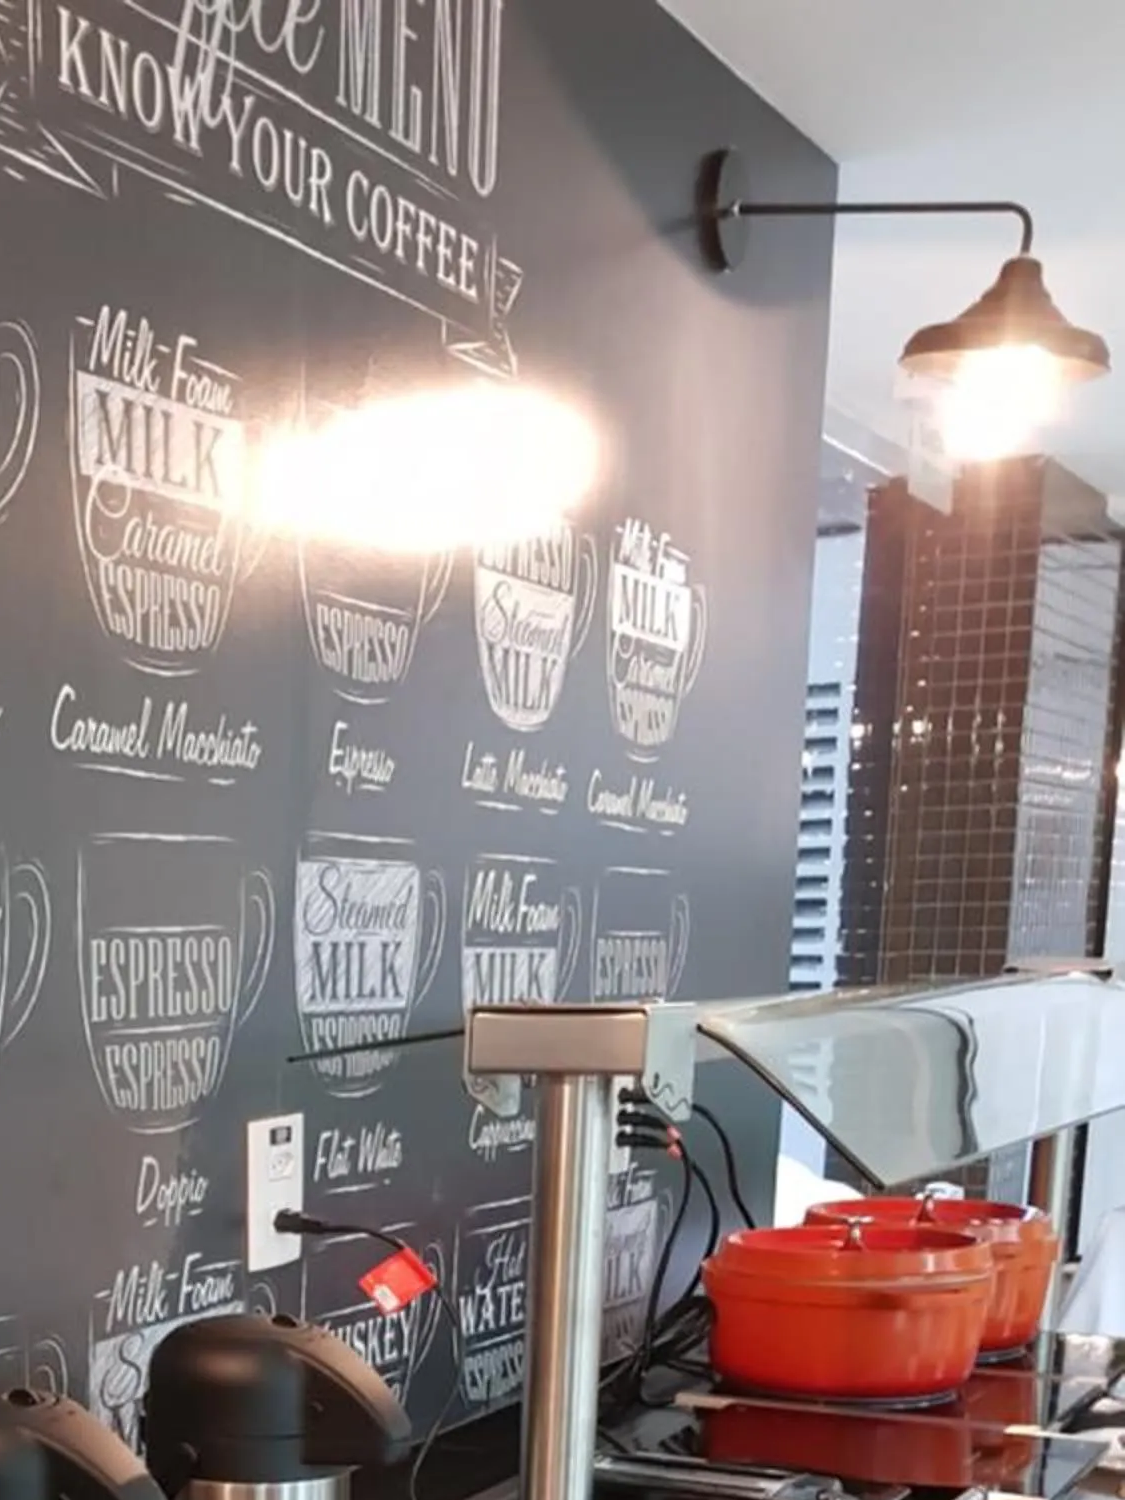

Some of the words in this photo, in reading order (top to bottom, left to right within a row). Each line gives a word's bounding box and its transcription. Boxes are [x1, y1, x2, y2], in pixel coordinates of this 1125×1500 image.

[56, 5, 203, 158] KNOW
[217, 92, 333, 225] YOUR
[345, 168, 479, 300] COFFEE
[88, 304, 162, 396] Milk
[171, 334, 235, 420] Foam
[92, 387, 225, 501] MILK
[85, 464, 227, 577] Caramel
[99, 558, 223, 652] ESPRESSO
[617, 573, 681, 644] MILK
[316, 603, 409, 684] ESPRESSO
[484, 641, 562, 712] MILK
[50, 684, 151, 761] Caramel
[156, 699, 262, 770] Macchiato
[303, 866, 415, 936] Steamed
[469, 870, 513, 932] Milk
[91, 936, 231, 1023] ESPRESSO
[310, 941, 405, 1000] MILK
[476, 952, 545, 1003] MILK
[106, 1036, 221, 1110] ESPRESSO
[137, 1156, 209, 1226] Doppio
[313, 1129, 356, 1182] Flat
[106, 1262, 168, 1333] Milk
[177, 1253, 234, 1314] Foam
[459, 1281, 525, 1336] WATE
